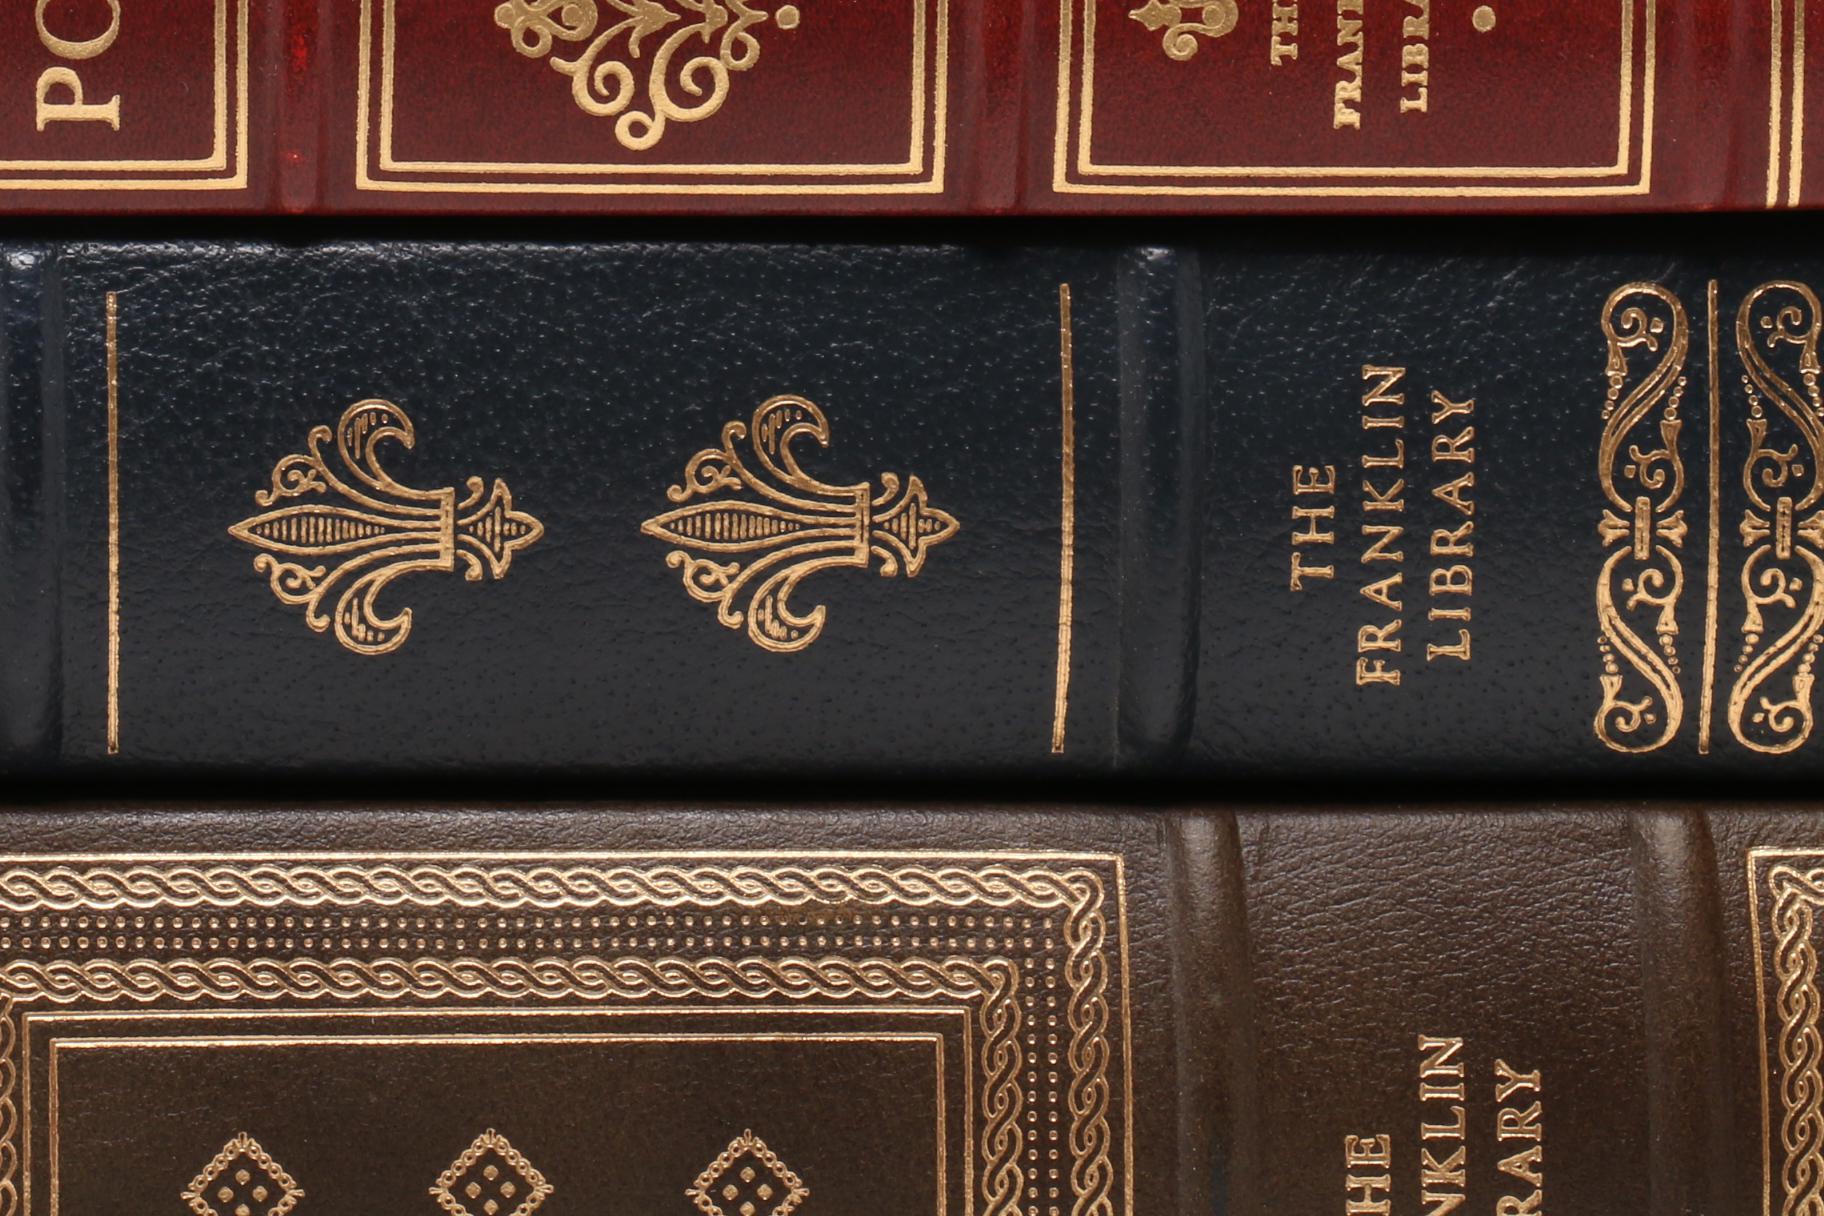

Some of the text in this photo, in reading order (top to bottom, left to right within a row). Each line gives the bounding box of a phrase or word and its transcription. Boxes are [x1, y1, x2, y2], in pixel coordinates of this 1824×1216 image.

[1290, 464, 1336, 592] THE
[1355, 363, 1407, 686] FRANKLIN
[1426, 389, 1475, 662] LIBRARY
